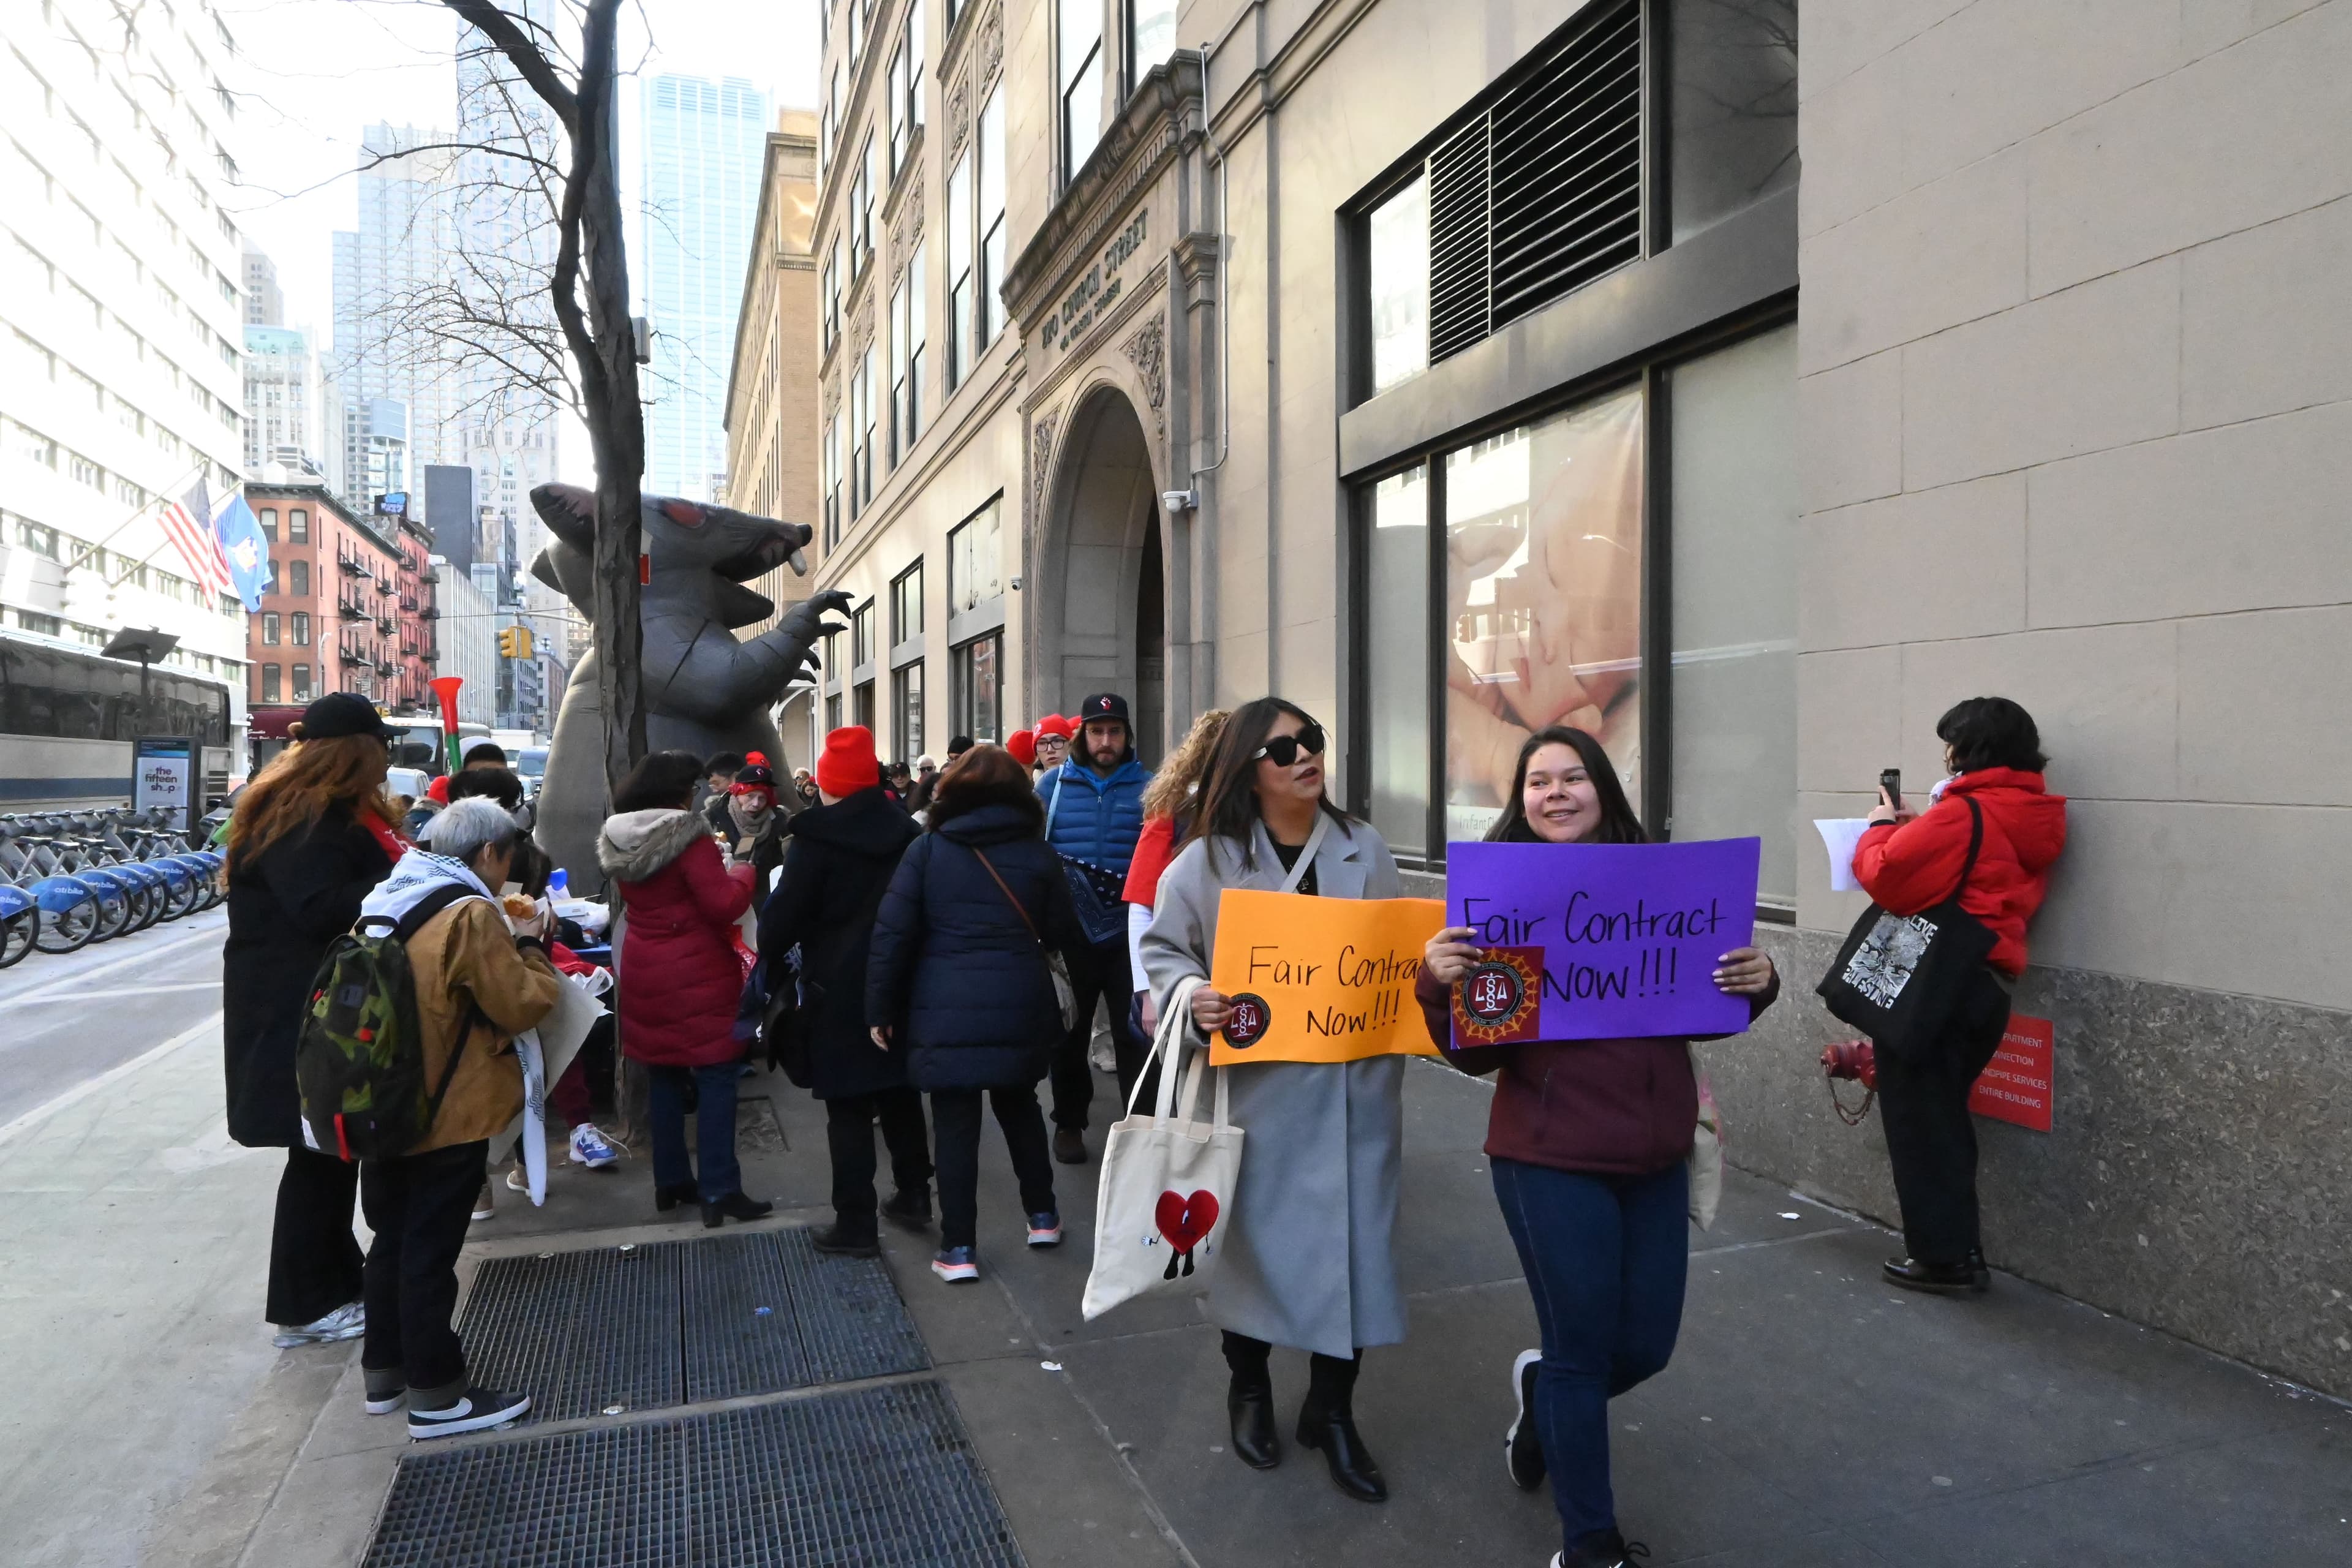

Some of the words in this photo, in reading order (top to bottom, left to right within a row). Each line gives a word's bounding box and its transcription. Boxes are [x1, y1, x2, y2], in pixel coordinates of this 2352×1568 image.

[145, 774, 178, 783] fifteen
[156, 766, 172, 775] the
[1463, 897, 1547, 946] Fair
[1565, 891, 1728, 944] Contract
[1910, 914, 1939, 944] LIVE
[1248, 945, 1323, 987] Fair
[1338, 945, 1422, 988] Contra
[1842, 966, 1896, 1010] PALESTINE
[2003, 1033, 2044, 1048] PARTMENT
[1992, 1050, 2034, 1066] NNECTION
[1982, 1068, 2011, 1081] NDPIPE
[2012, 1074, 2047, 1090] SERVICES
[1979, 1085, 2003, 1099] ENTIRE
[2005, 1091, 2041, 1109] BUILDING
